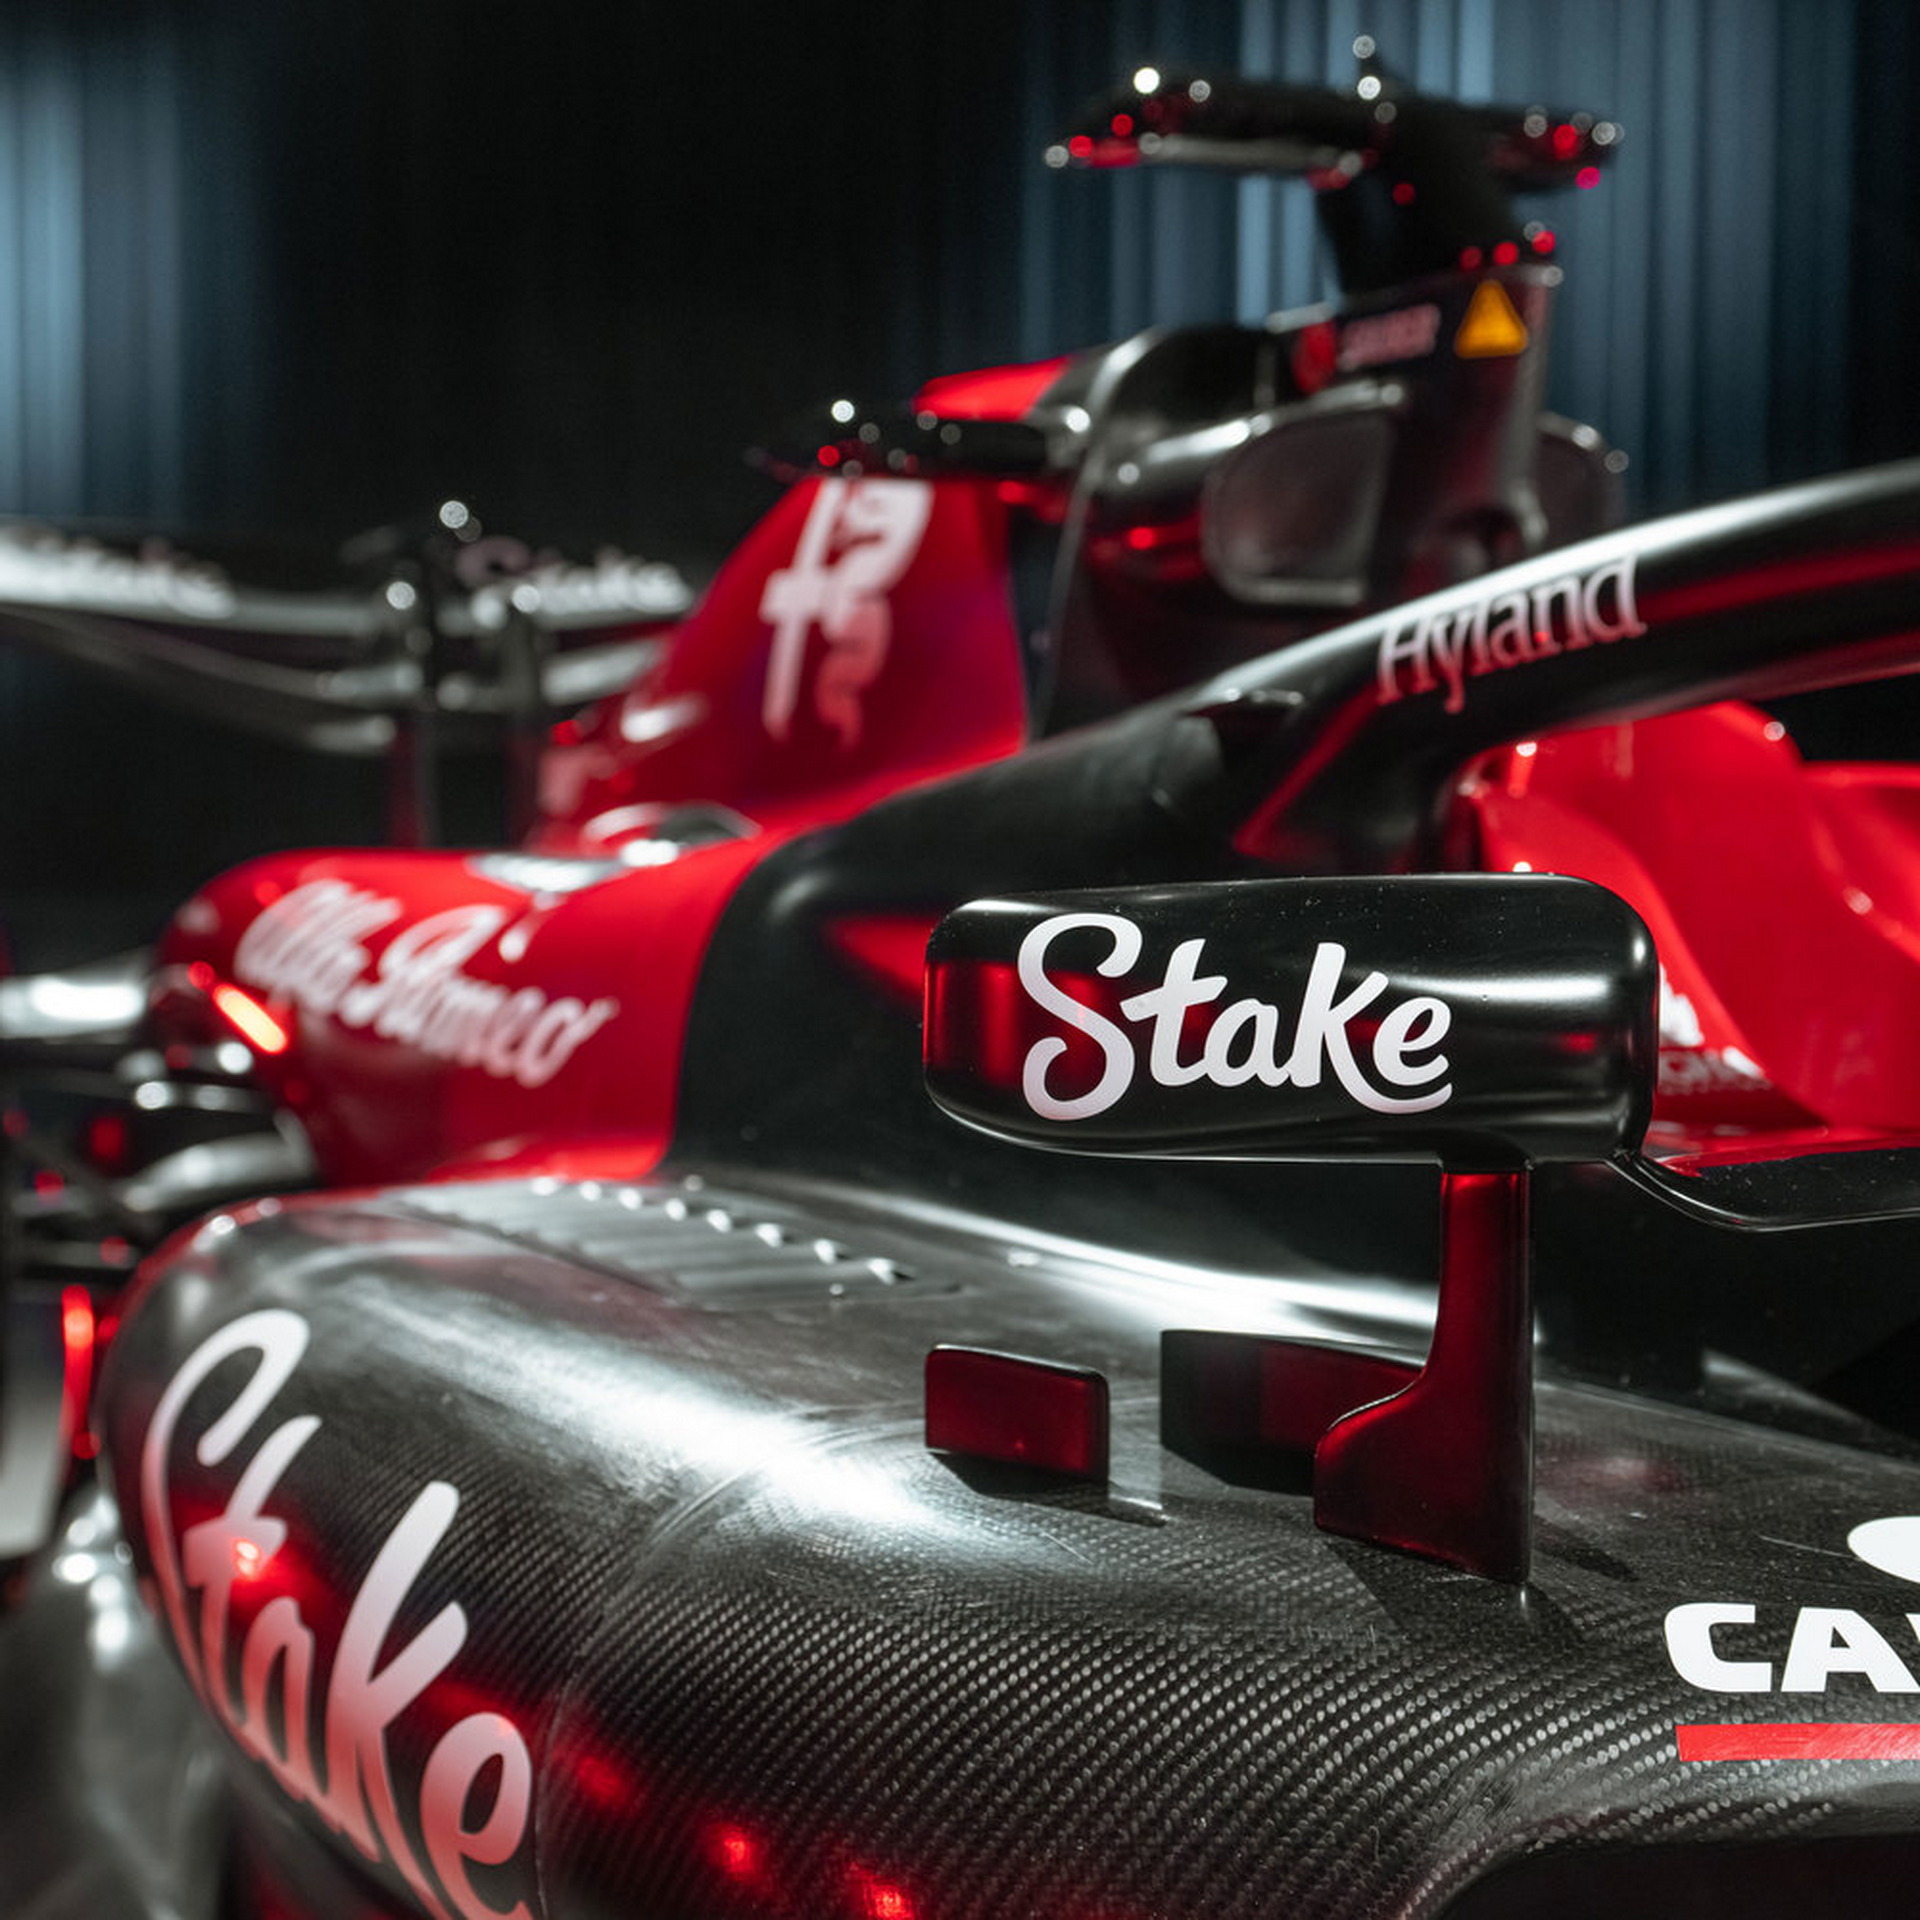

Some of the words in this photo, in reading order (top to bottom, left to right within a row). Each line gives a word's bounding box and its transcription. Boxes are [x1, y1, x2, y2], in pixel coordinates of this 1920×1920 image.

[1377, 554, 1647, 714] Hyland
[1019, 914, 1452, 1119] Stake
[1664, 1602, 1920, 1693] CA
